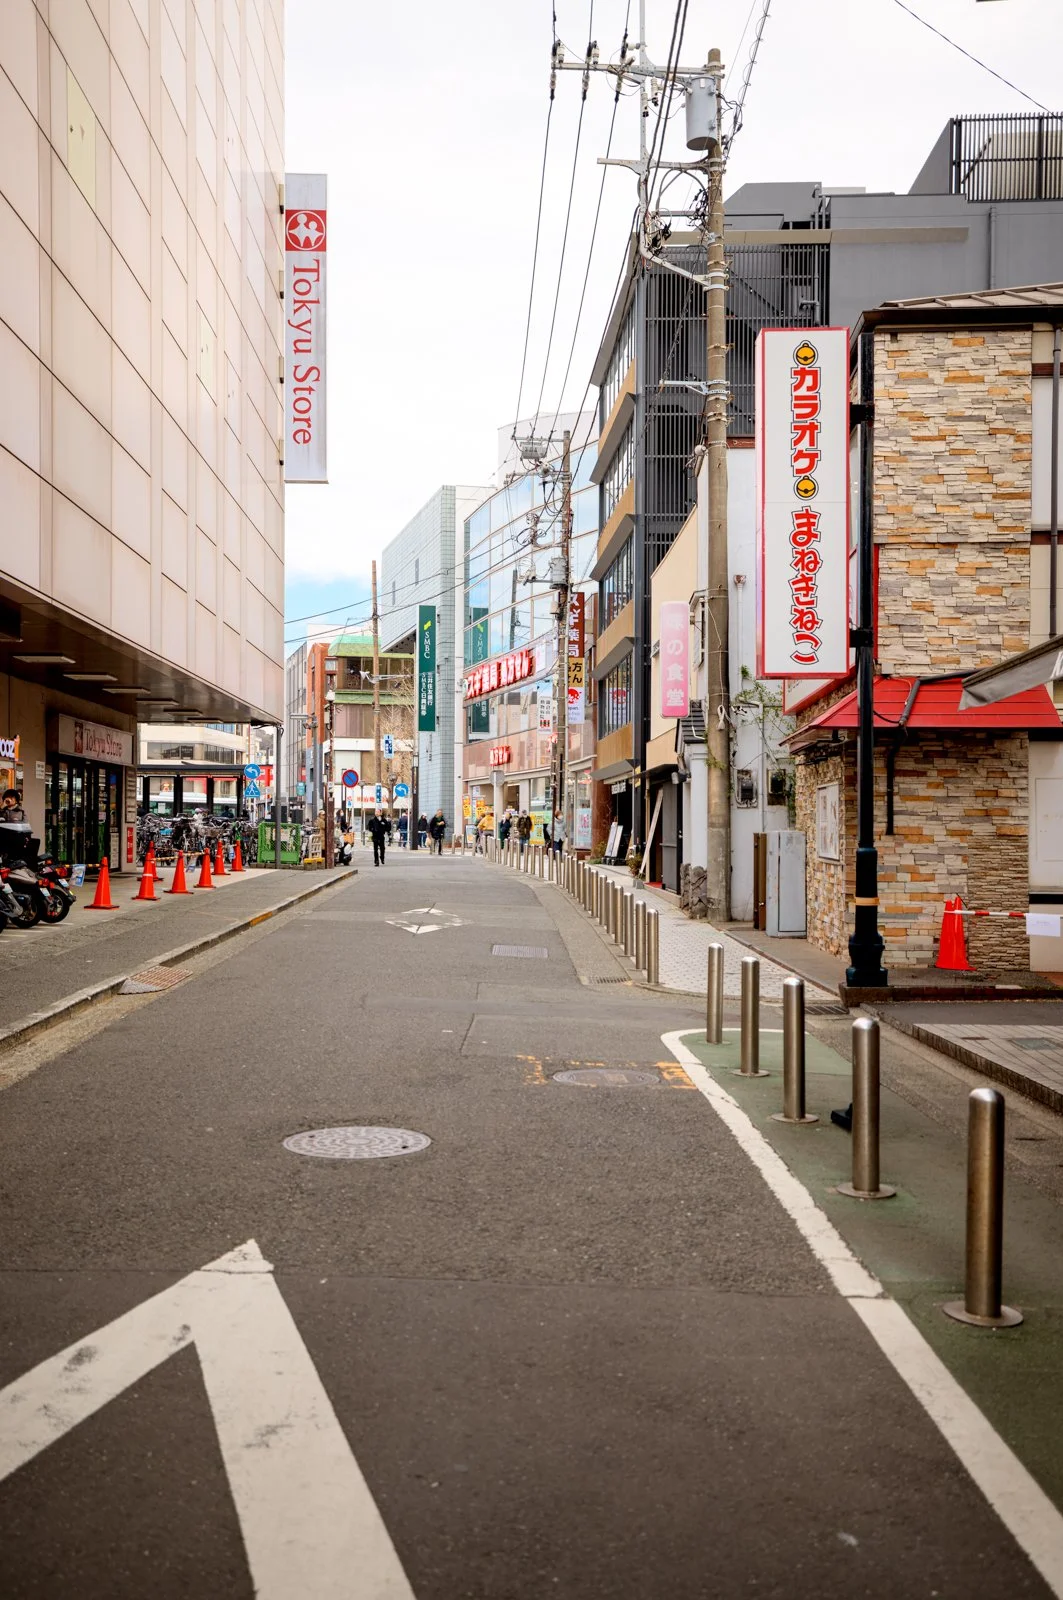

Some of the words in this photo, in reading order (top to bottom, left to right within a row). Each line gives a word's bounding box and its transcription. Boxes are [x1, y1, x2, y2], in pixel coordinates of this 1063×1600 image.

[288, 258, 320, 355] Tokyu
[292, 365, 320, 445] Store
[791, 367, 821, 477] カラオケ
[789, 505, 823, 666] まねきねこ
[423, 631, 431, 659] SMBC
[466, 662, 499, 699] スギ薬局
[84, 728, 106, 758] Tokyu
[106, 731, 123, 757] Store
